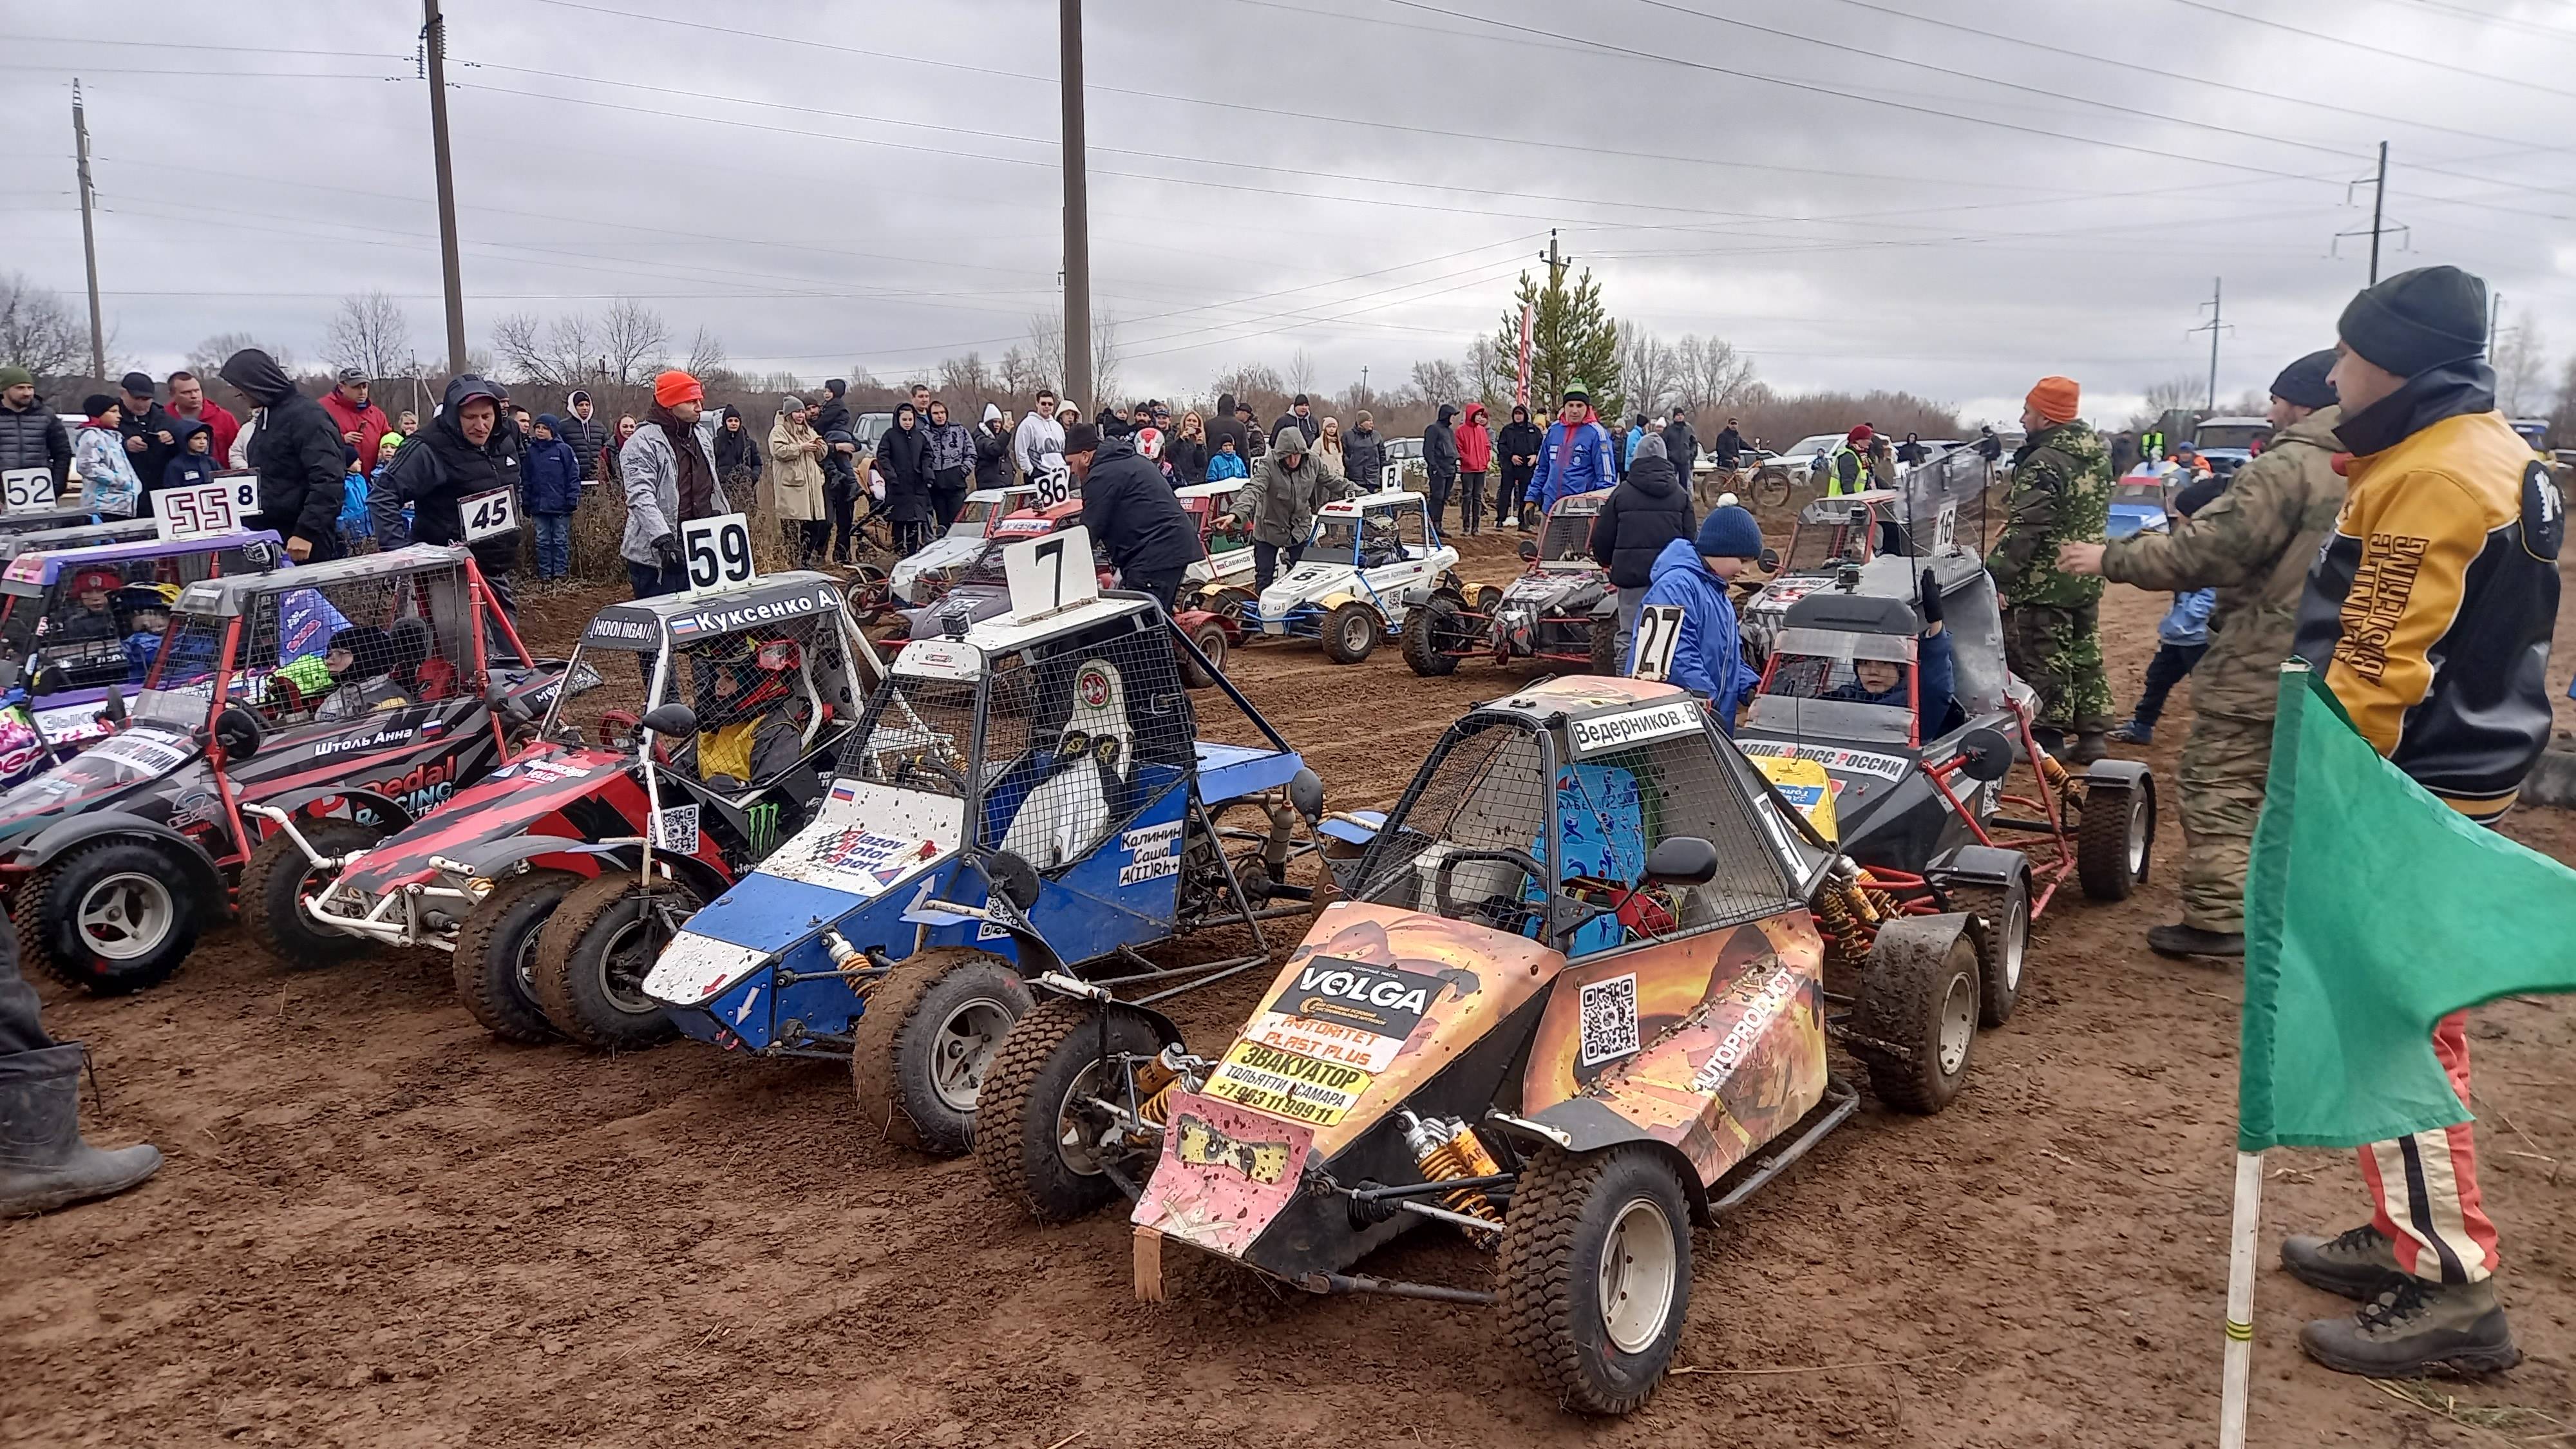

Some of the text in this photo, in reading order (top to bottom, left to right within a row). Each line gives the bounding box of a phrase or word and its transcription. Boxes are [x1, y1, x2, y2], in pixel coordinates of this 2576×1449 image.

[7, 475, 54, 506] 52
[238, 484, 254, 506] 8
[1038, 473, 1067, 507] 86
[1387, 468, 1396, 488] 8
[471, 497, 507, 529] 45
[1940, 509, 1953, 545] 16
[687, 524, 751, 587] 59
[1035, 538, 1065, 608] 7
[695, 596, 813, 632] Куксенко
[1638, 607, 1681, 675] 27
[315, 728, 413, 755] Штоль Анна
[1738, 743, 1903, 777] АЛЛИ-КРОСС РОССИИ
[837, 842, 893, 860] Motor
[1122, 827, 1181, 850] Калинин
[1133, 847, 1169, 864] Саша
[827, 853, 883, 873] Sport
[1299, 967, 1427, 1016] VOLGA
[1692, 967, 1795, 1092] AUTOPRODUCT
[1263, 1032, 1372, 1066] PLAST PLUS
[1240, 1046, 1361, 1090] ЭВАКУАТОР
[1218, 1083, 1238, 1096] +7
[1266, 1095, 1285, 1110] 11
[1282, 1099, 1317, 1119] 999
[1314, 1107, 1334, 1123] 11
[1226, 1065, 1347, 1108] ТОЛЬЯТТИ САМАРА
